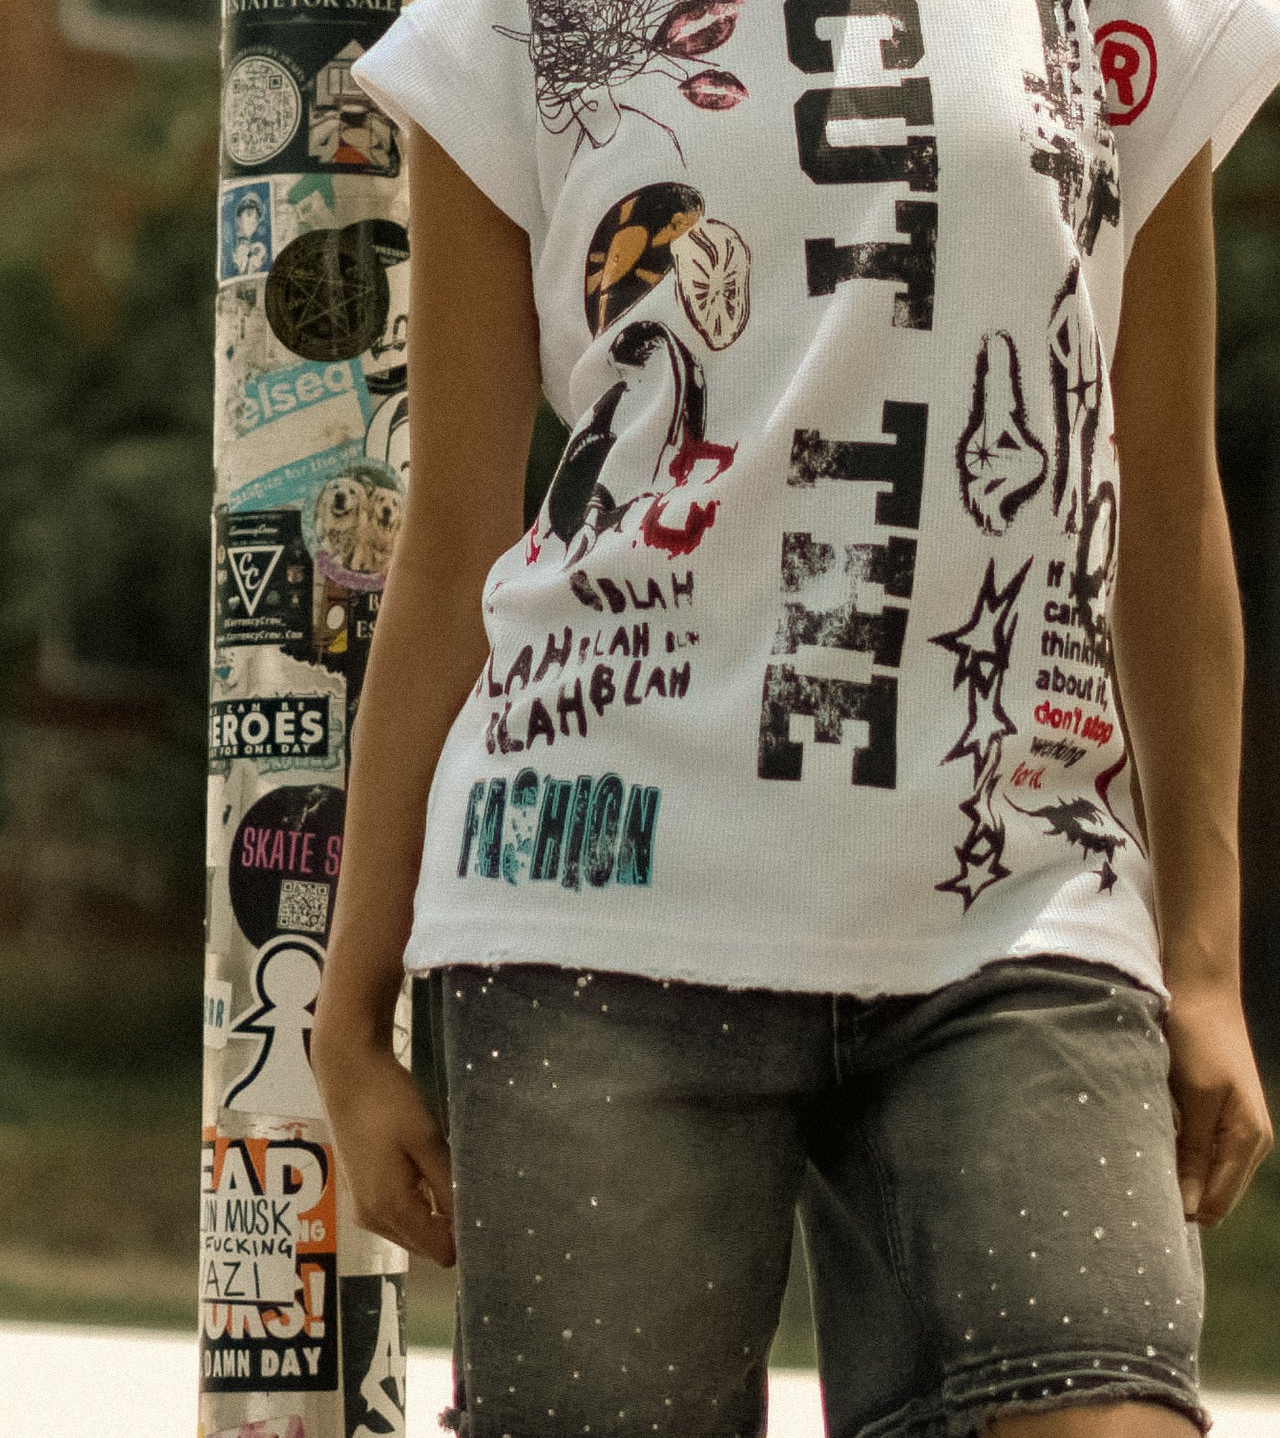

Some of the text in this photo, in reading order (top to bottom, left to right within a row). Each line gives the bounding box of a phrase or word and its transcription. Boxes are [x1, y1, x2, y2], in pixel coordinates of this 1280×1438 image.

[756, 400, 929, 790] THE
[1035, 665, 1093, 701] about
[227, 703, 262, 714] CAN
[282, 700, 306, 712] BE
[1033, 700, 1083, 734] don't
[211, 709, 325, 747] EROES
[244, 743, 273, 755] ONE
[281, 743, 311, 754] DAY
[456, 767, 661, 896] FASHION
[241, 827, 316, 874] SKATE
[225, 1199, 292, 1236] MUSK
[206, 1236, 292, 1259] FUCKING
[204, 1260, 261, 1299] AZI
[204, 1347, 322, 1378] DAMN DAY
